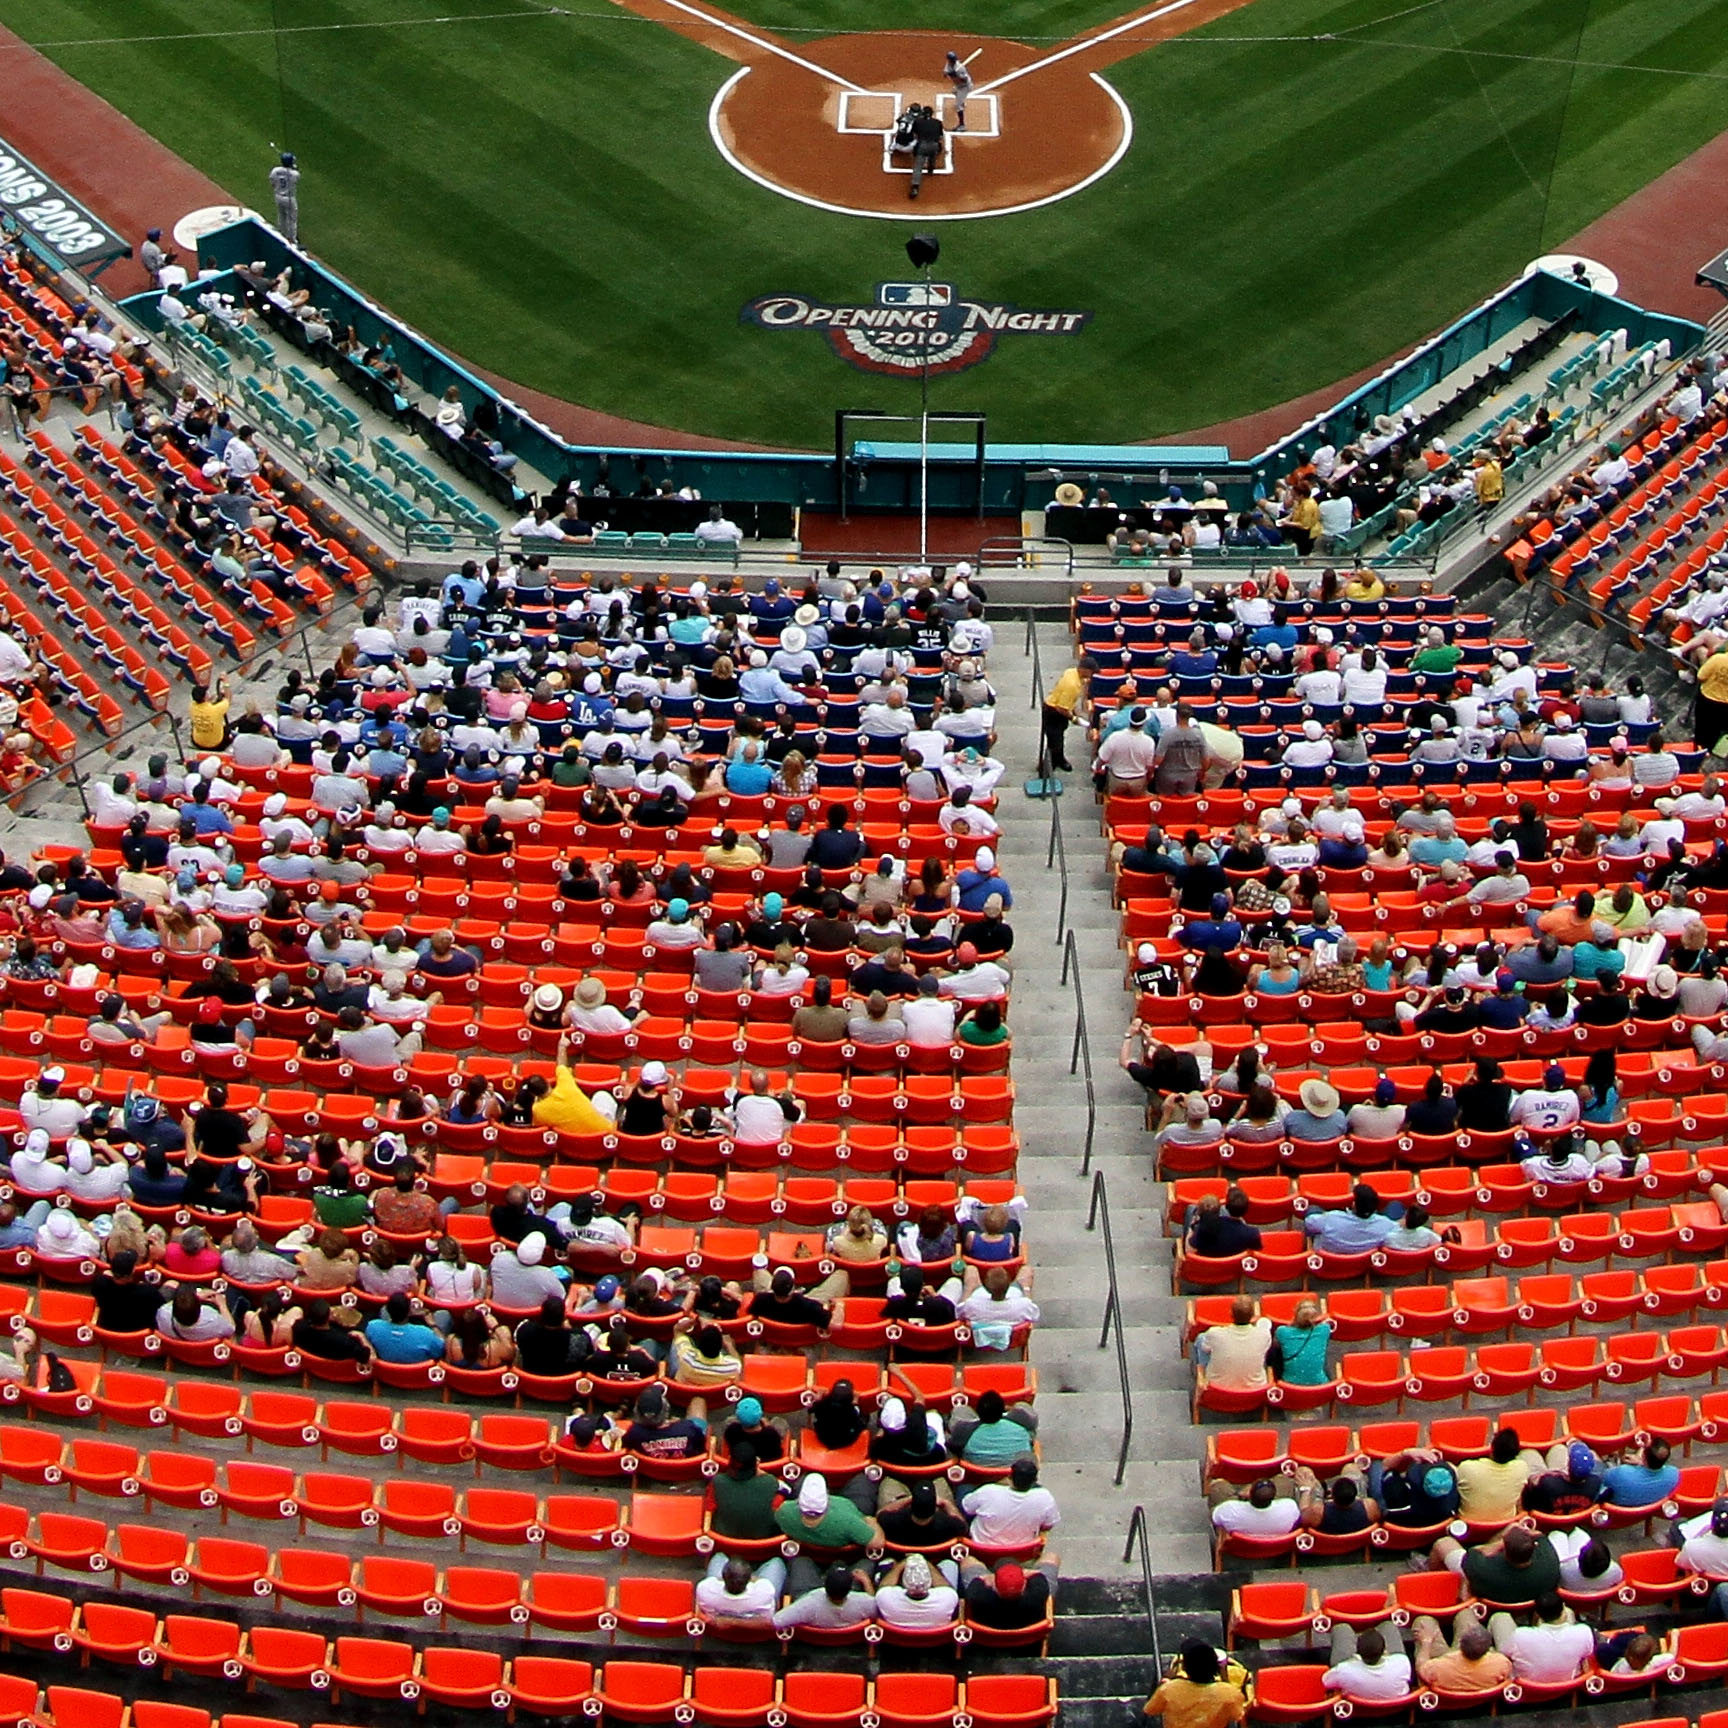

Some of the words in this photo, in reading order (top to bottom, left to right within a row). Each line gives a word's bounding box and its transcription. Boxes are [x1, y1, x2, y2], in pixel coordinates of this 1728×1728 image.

[16, 198, 105, 255] 2003
[754, 297, 939, 329] OPENING
[958, 302, 1083, 332] NIGHT
[874, 331, 943, 346] 2010
[579, 701, 598, 723] LA
[1534, 1100, 1570, 1113] RAMIREZ
[1542, 1113, 1559, 1129] 2
